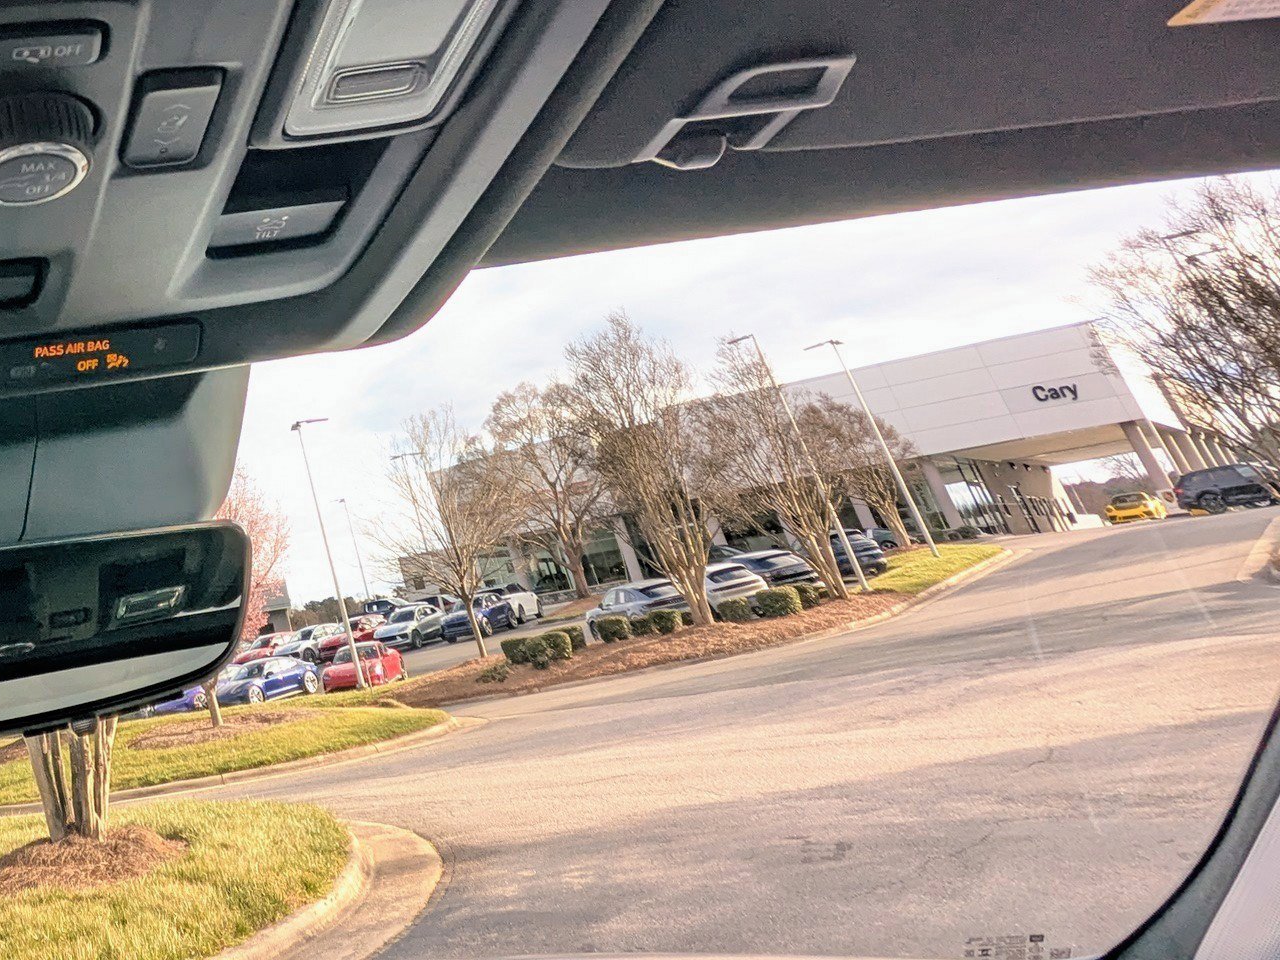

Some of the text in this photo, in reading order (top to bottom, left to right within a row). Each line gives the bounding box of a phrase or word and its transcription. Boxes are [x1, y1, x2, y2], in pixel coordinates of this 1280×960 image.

[53, 44, 82, 57] OFF
[21, 162, 56, 173] MAX
[25, 184, 51, 194] OFF
[256, 230, 279, 240] TILT
[34, 340, 110, 358] PASS AIR BAG
[76, 359, 99, 371] OFF
[1032, 383, 1079, 402] Cary
